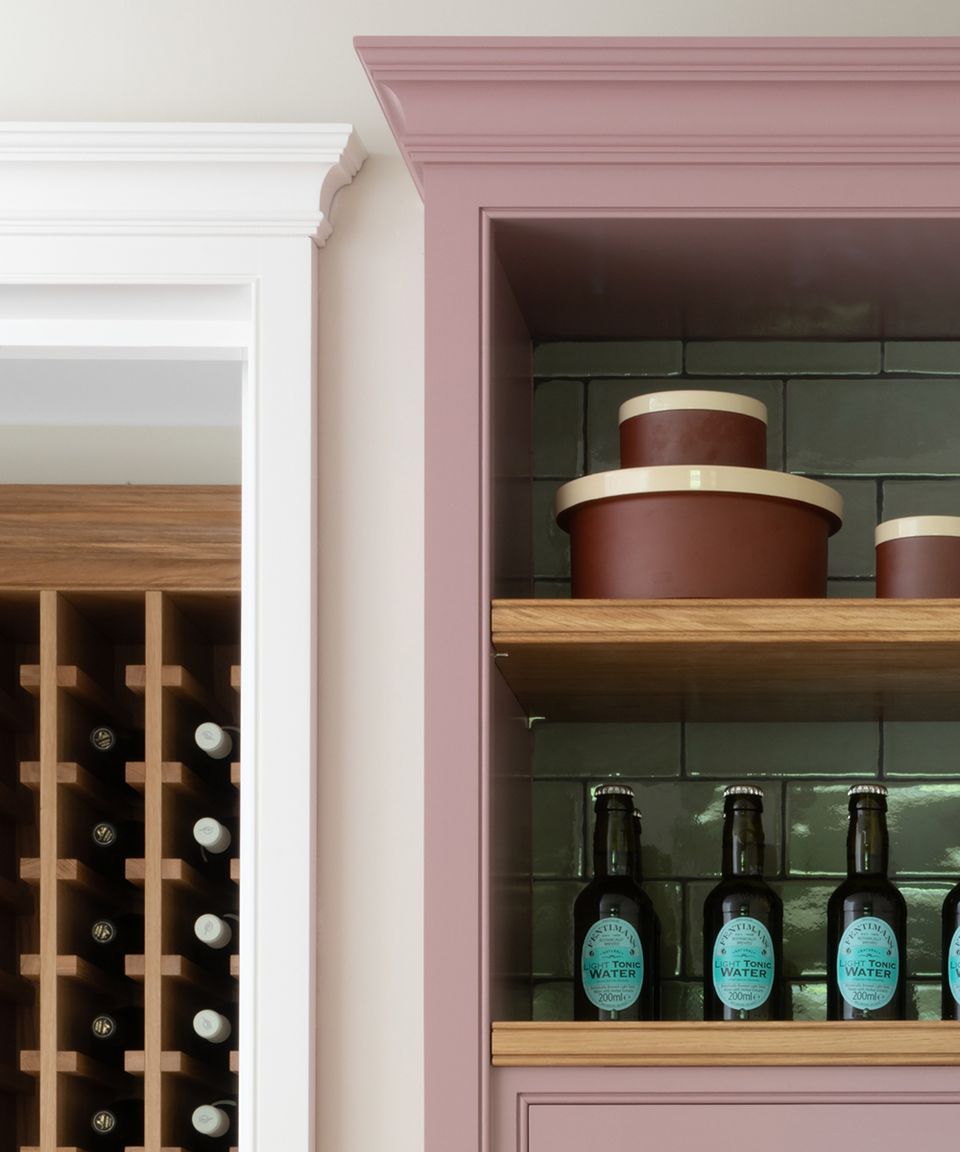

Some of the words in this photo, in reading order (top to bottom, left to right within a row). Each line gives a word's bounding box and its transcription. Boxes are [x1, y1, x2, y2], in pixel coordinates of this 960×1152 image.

[584, 961, 609, 971] LIGHT
[611, 961, 640, 969] TONIC
[715, 960, 740, 968] LIGHT
[743, 960, 772, 969] TONIC
[840, 960, 865, 968] LIGHT
[868, 960, 896, 969] TONIC
[590, 969, 636, 979] WATER
[721, 968, 767, 978] WATER
[845, 967, 891, 978] WATER
[599, 992, 623, 1002] 200ml
[728, 992, 752, 1001] 200ml
[853, 992, 877, 1001] 200ml
